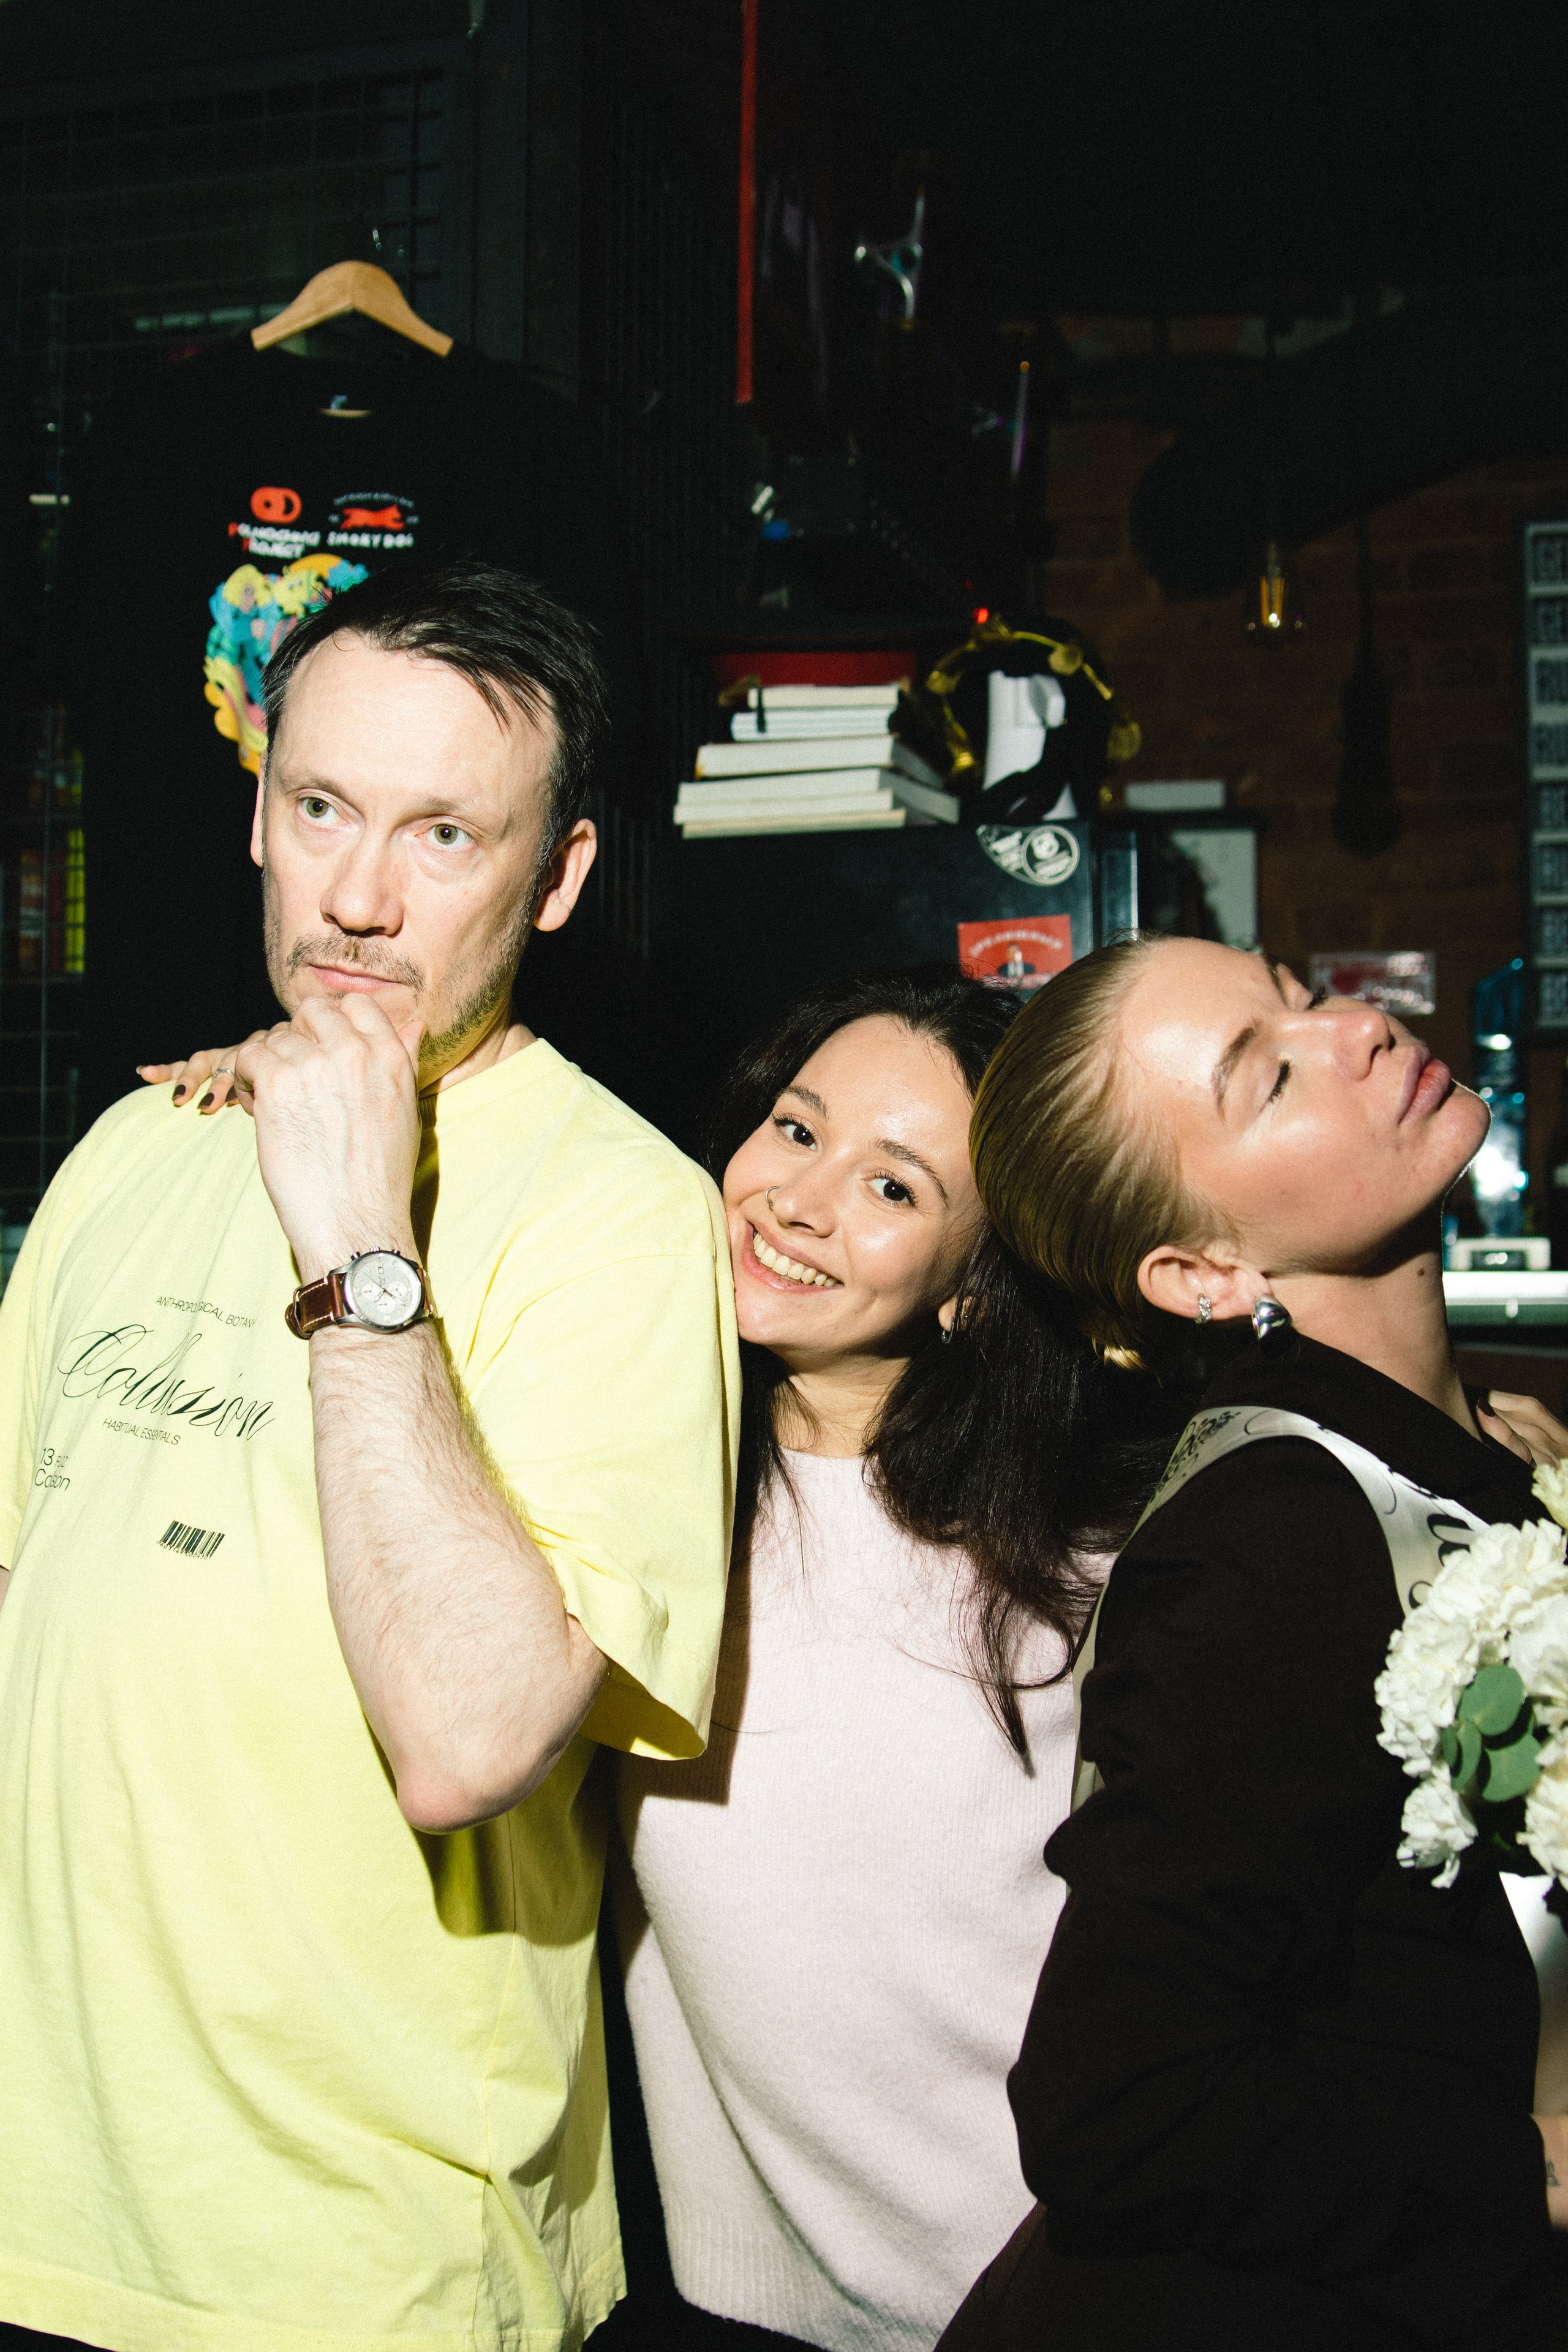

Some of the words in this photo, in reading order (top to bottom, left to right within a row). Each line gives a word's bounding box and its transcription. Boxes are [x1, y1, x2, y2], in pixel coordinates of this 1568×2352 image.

[225, 1314, 256, 1328] BOTANY
[103, 1418, 140, 1437] HABITUAL
[40, 1447, 55, 1466] 13
